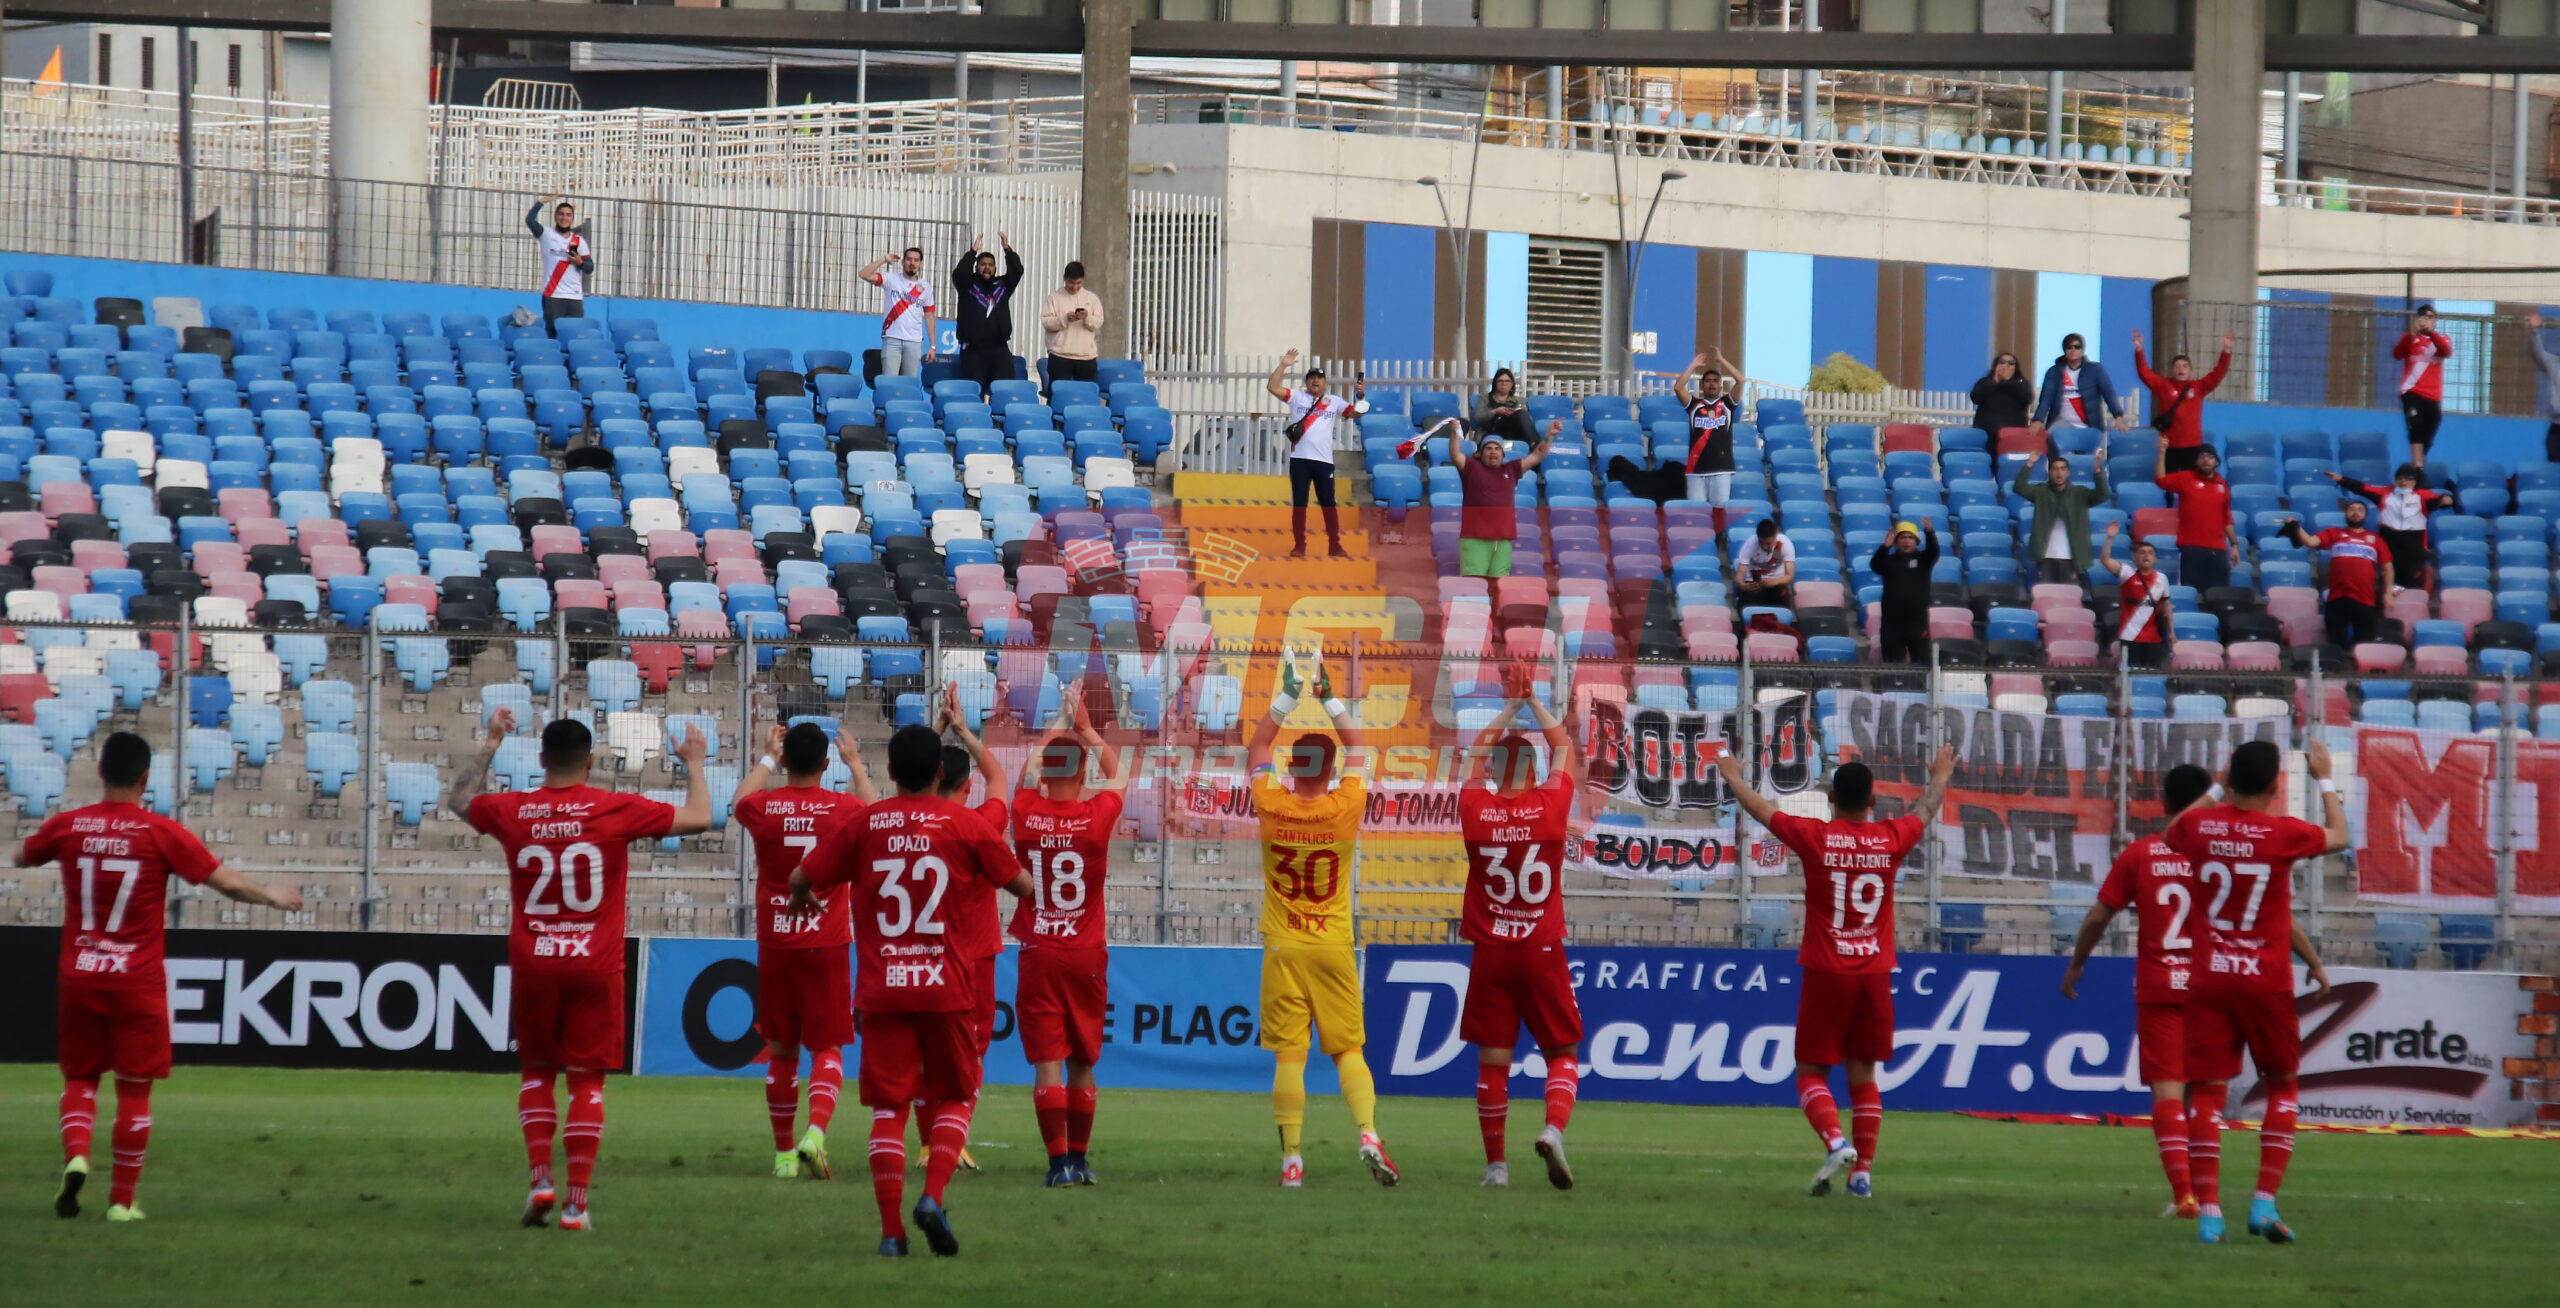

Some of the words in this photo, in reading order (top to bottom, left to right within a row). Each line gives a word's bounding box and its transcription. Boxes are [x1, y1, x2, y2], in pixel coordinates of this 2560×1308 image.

[1850, 696, 2070, 798] SAGRADA
[2082, 719, 2276, 800] FMIL
[765, 807, 795, 815] MAIPO
[1394, 792, 1461, 825] TOMA
[1480, 814, 1508, 822] MAIPO
[531, 821, 582, 839] CASTRO
[784, 817, 814, 832] FRITZ
[870, 819, 905, 830] MAIPO
[1025, 821, 1055, 832] MAIPO
[1492, 826, 1532, 842] MUÑOZ
[82, 836, 130, 855] CORTES
[888, 834, 930, 853] OPAZO
[1040, 834, 1073, 849] ORTIZ
[1276, 828, 1335, 845] SANTELICES
[1827, 840, 1857, 849] MAIPO
[1959, 804, 2093, 882] DEL
[784, 835, 817, 863] 7
[1594, 832, 1723, 873] BOLDO
[2150, 847, 2182, 856] MAIP
[2210, 840, 2254, 858] COELHO
[1824, 852, 1838, 867] DE
[1840, 853, 1854, 868] LA
[1856, 853, 1892, 868] FUENTE
[2152, 861, 2193, 877] ORMAZ
[516, 842, 604, 915] 20
[1028, 849, 1086, 911] 18
[1270, 843, 1339, 905] 30
[1479, 844, 1552, 905] 36
[77, 857, 140, 933] 17
[872, 855, 949, 938] 32
[1831, 871, 1885, 929] 19
[2200, 861, 2271, 931] 27
[2157, 882, 2192, 950] 2
[545, 921, 596, 934] multihogar
[1052, 920, 1079, 937] TX
[554, 936, 590, 957] TX
[898, 944, 945, 957] multihogar
[97, 952, 129, 974] TX
[2229, 956, 2261, 976] TX
[907, 964, 945, 988] TX
[1133, 1003, 1261, 1047] PLAG
[2297, 1103, 2384, 1122] onstrucción
[2388, 1109, 2400, 1122] y
[2404, 1106, 2473, 1125] Servicios
